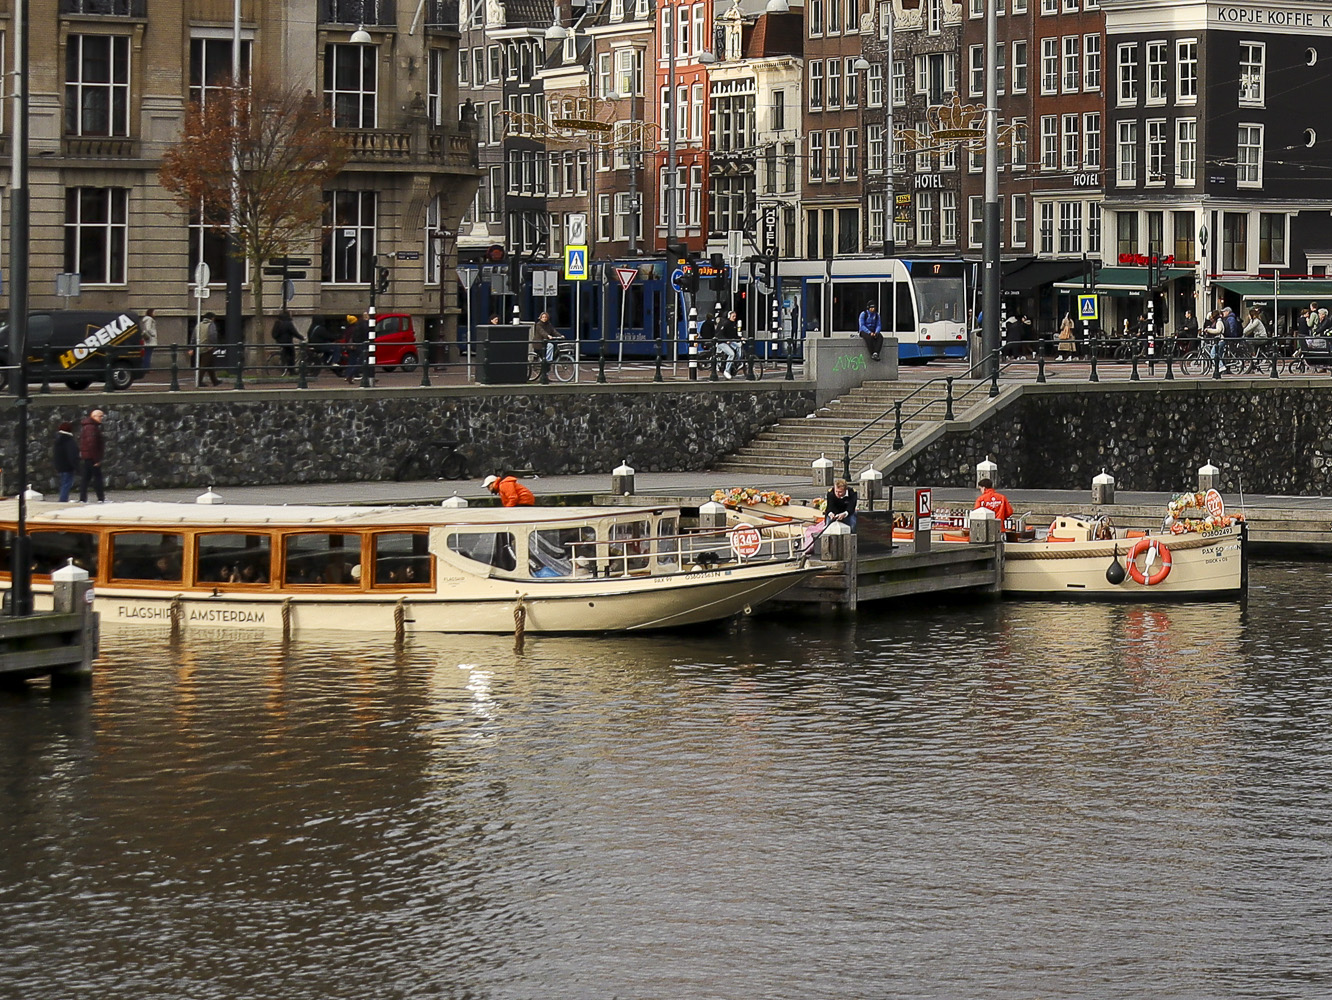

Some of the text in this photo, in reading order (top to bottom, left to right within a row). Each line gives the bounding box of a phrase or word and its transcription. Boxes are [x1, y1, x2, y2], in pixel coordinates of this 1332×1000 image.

[1217, 7, 1263, 23] KOPJE
[1267, 10, 1313, 26] KOFFIE
[914, 174, 943, 189] HOTEL
[1073, 173, 1099, 186] HOTEL
[932, 264, 941, 274] 17
[58, 313, 135, 370] HOBEKA
[190, 609, 265, 623] AMSTERDAM
